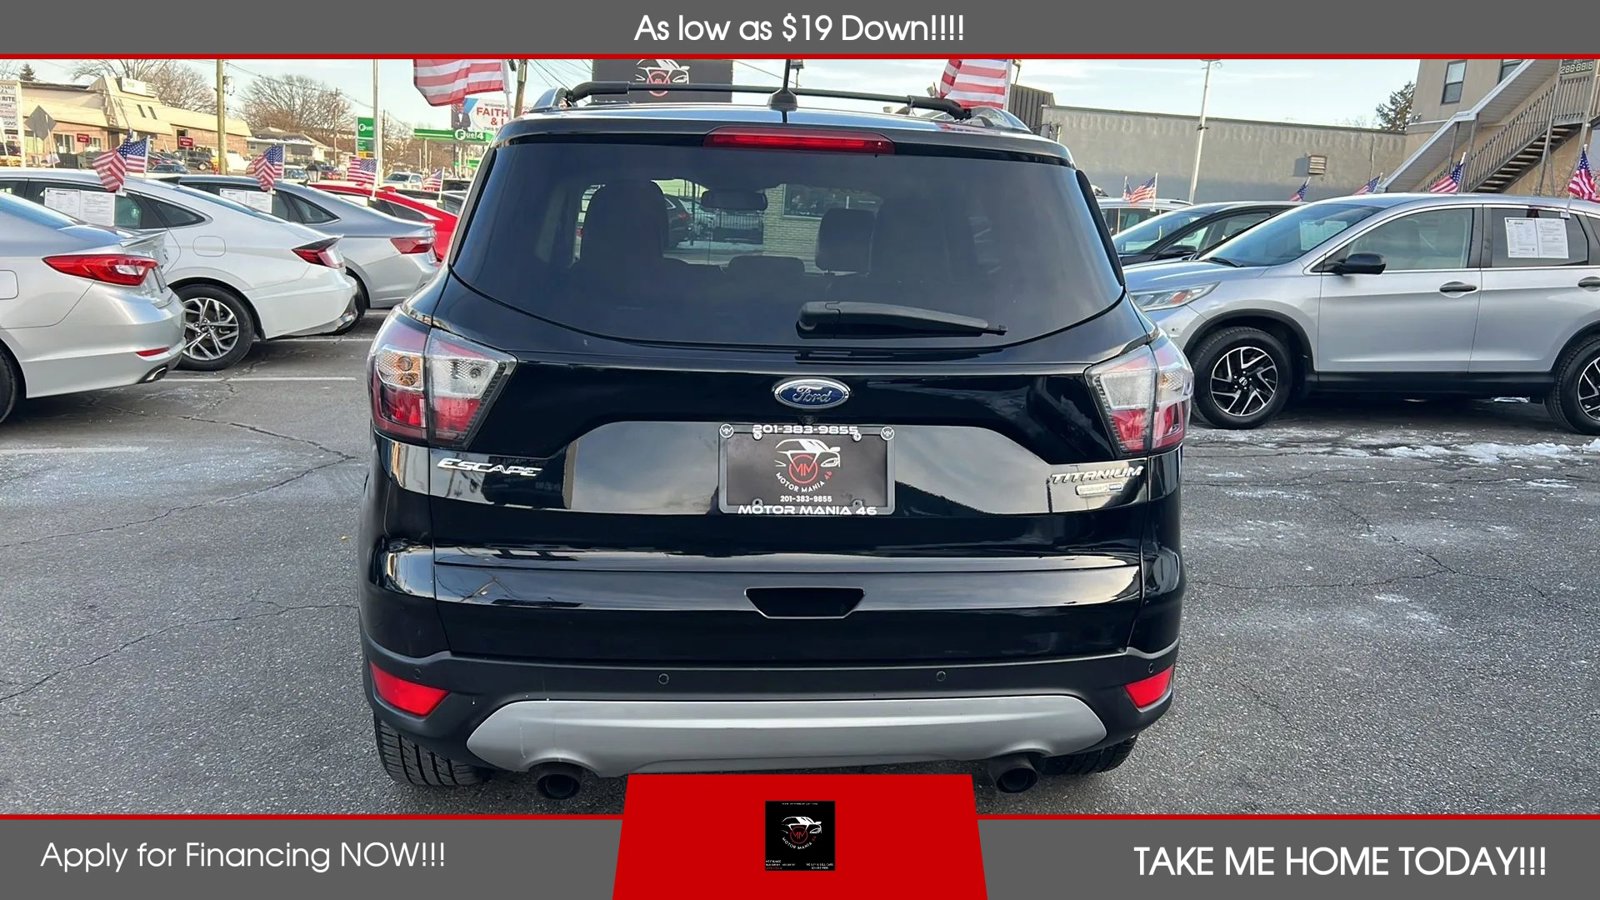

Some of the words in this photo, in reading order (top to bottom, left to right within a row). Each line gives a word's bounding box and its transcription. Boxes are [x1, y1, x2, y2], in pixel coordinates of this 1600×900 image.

[476, 107, 509, 117] FAITH
[792, 385, 832, 402] Ford
[752, 424, 860, 435] 201-383-9855
[436, 457, 544, 477] ESCAPE
[1051, 465, 1144, 483] TITANIUM
[775, 471, 800, 492] MOTOR
[800, 480, 825, 493] MANIA
[779, 495, 833, 503] 201-383-9855
[737, 505, 796, 515] MOTOR
[799, 505, 853, 515] MANIA
[855, 506, 878, 515] 46
